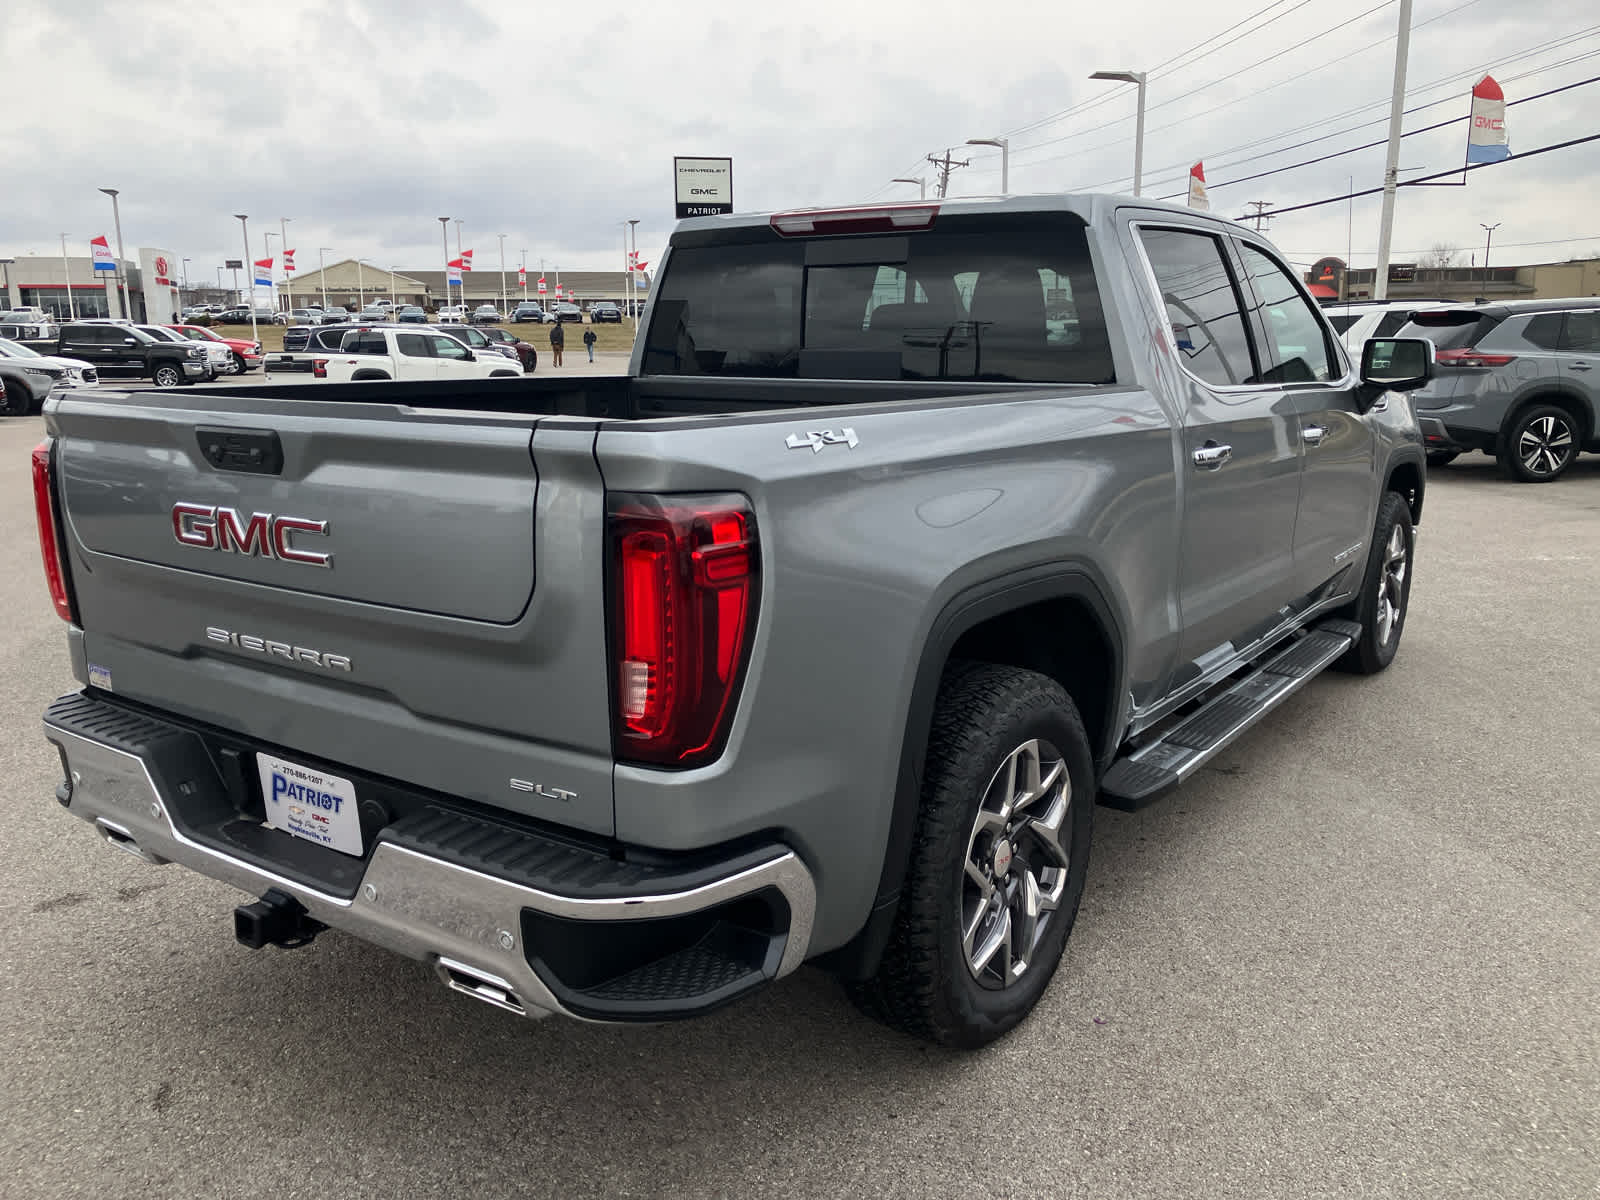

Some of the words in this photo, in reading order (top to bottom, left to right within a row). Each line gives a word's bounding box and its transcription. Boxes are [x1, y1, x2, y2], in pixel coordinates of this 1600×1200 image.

[1475, 115, 1503, 130] GMC
[687, 207, 722, 215] PATRIOT
[172, 501, 333, 569] GMC
[206, 626, 354, 672] SIERRA
[271, 771, 343, 813] PATRIOT
[509, 778, 578, 801] SLT
